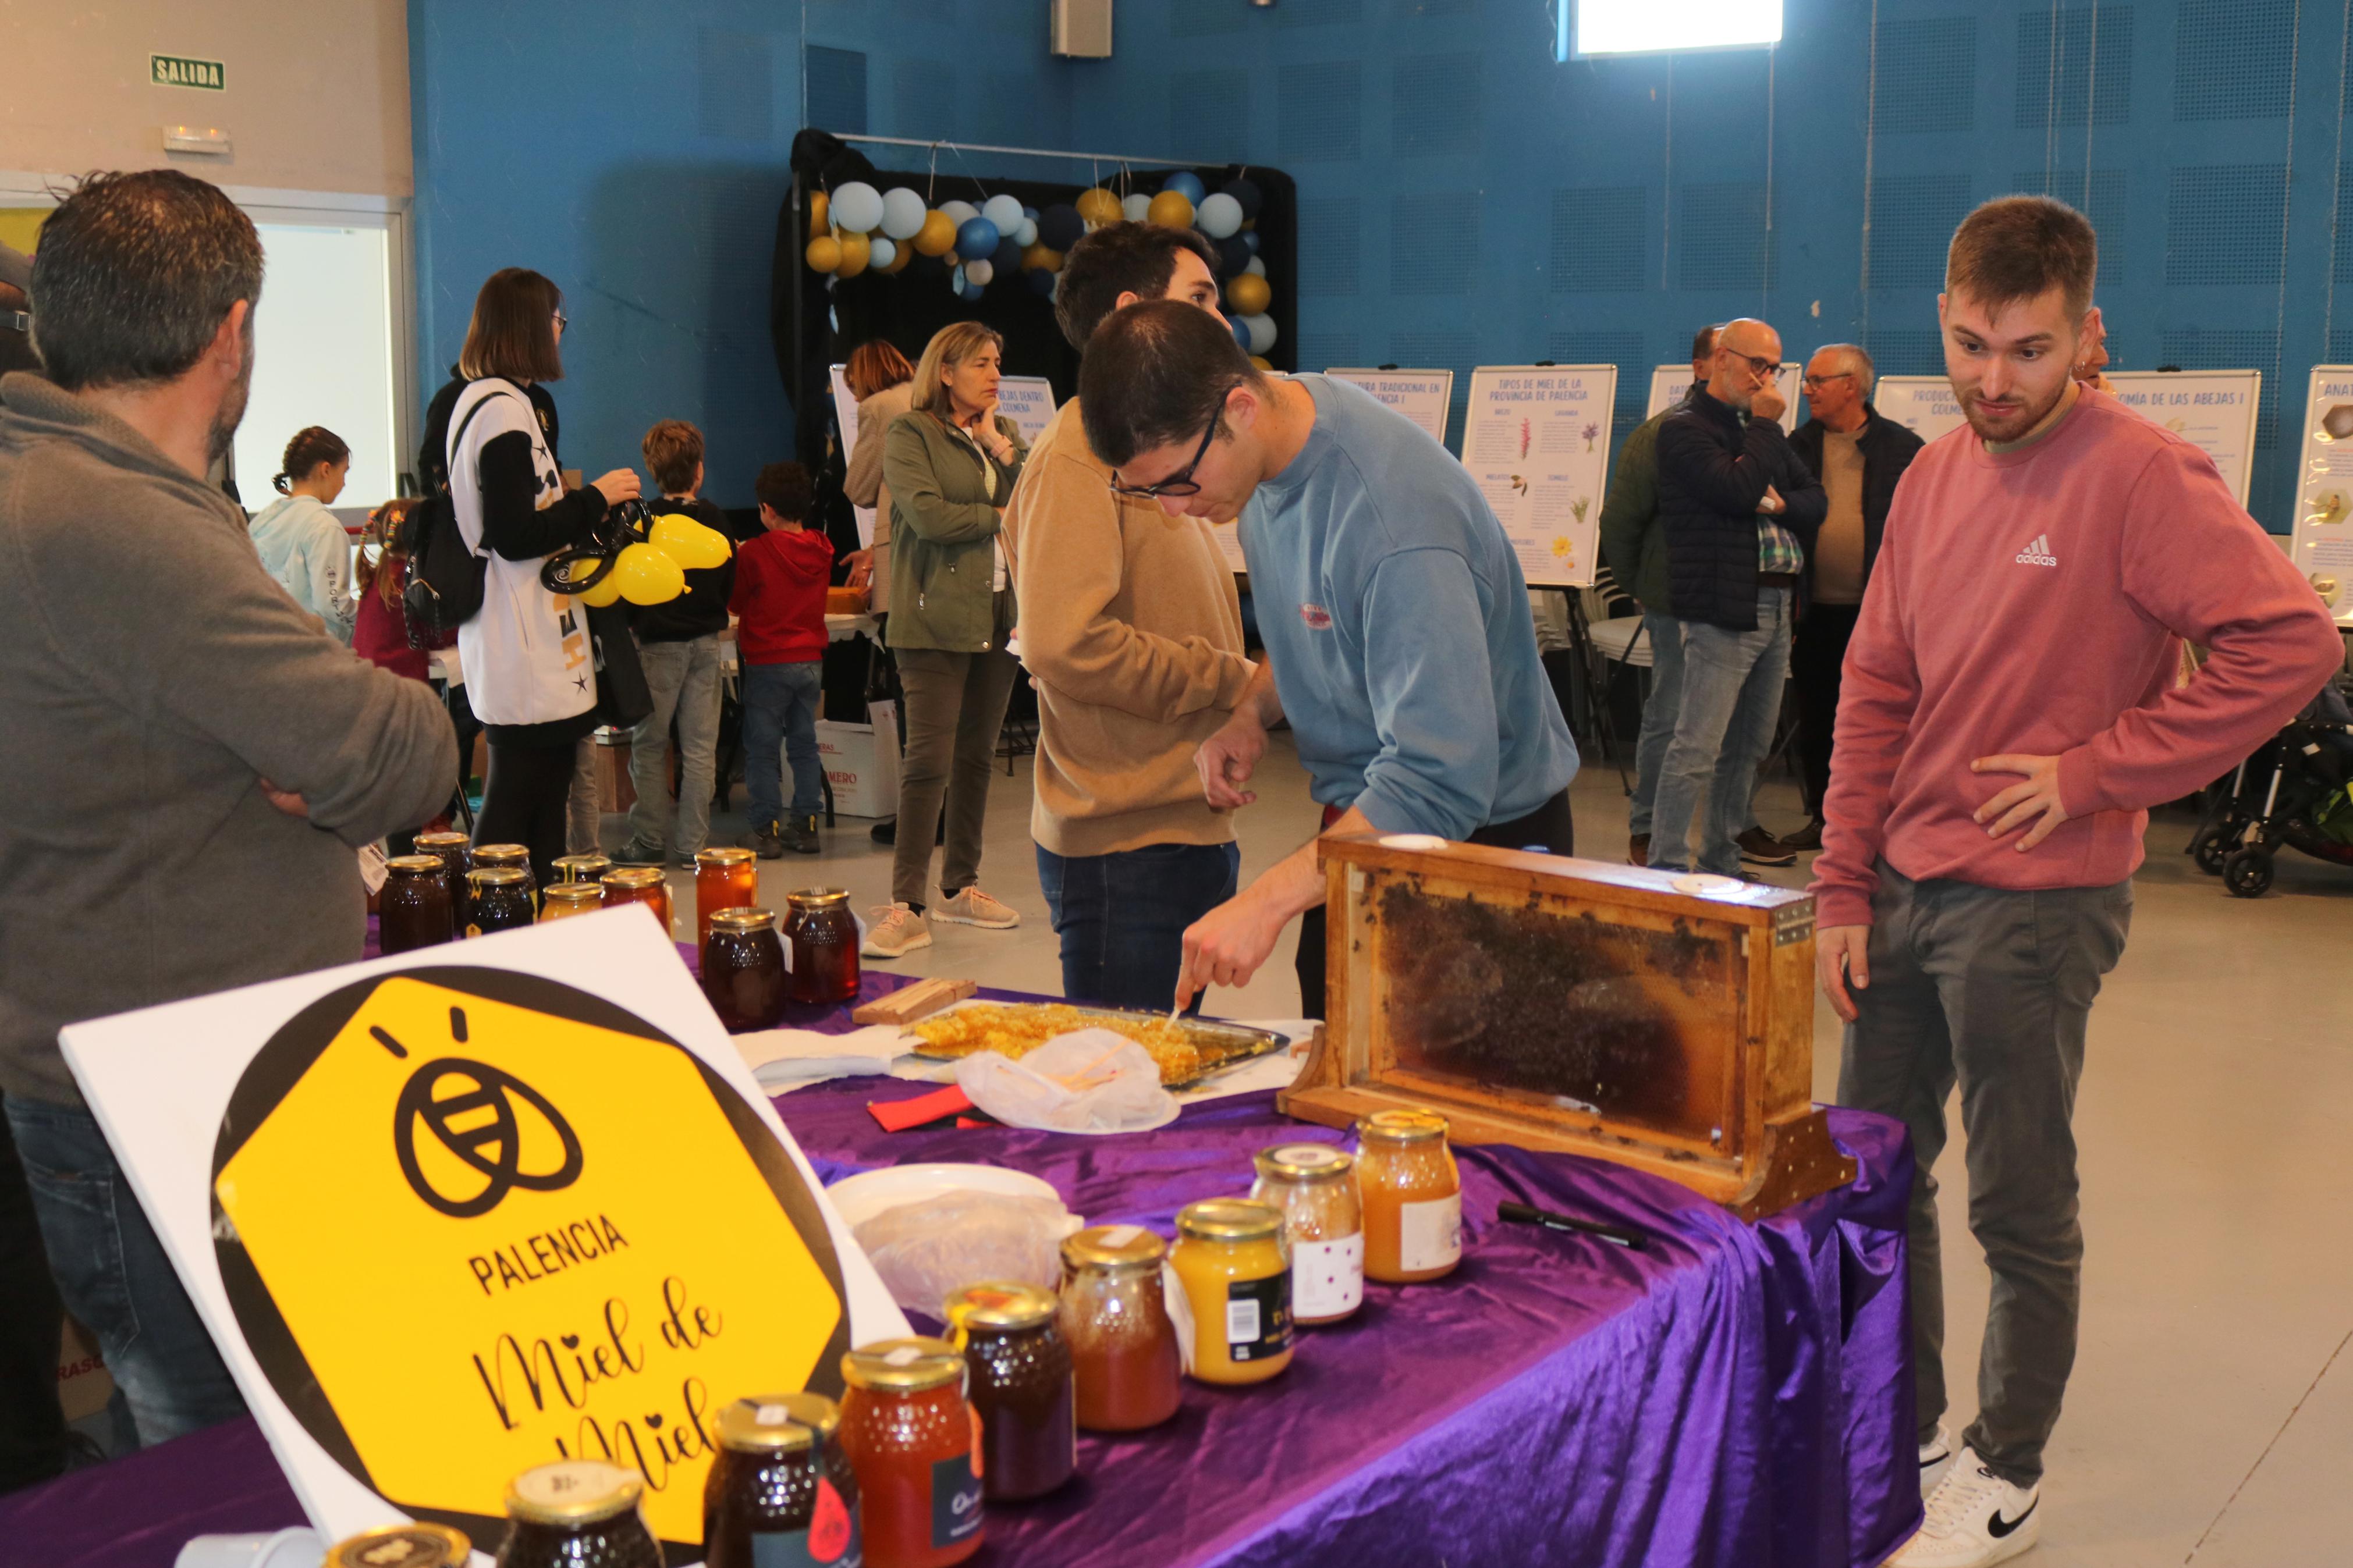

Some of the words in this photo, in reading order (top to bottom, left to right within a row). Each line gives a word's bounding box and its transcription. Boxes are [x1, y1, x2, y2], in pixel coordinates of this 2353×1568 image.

[156, 59, 219, 86] SALIDA
[1354, 382, 1375, 392] TURA
[1379, 382, 1426, 392] TRADICIONAL
[1429, 383, 1440, 393] EN
[1499, 379, 1521, 389] TIPOS
[1524, 379, 1533, 389] DE
[1537, 380, 1555, 389] MIEL
[1558, 379, 1568, 389] DE
[1571, 379, 1581, 389] LA
[998, 390, 1018, 400] BEJAS
[1374, 393, 1399, 404] ENCIA
[1489, 391, 1533, 401] PROVINCIA
[1536, 391, 1545, 401] DE
[1549, 391, 1588, 401] PALENCIA
[2119, 392, 2146, 406] OMÍA
[2152, 393, 2164, 406] DE
[2170, 393, 2189, 406] LAS
[2194, 393, 2235, 406] ABEJAS
[2240, 393, 2244, 404] I
[1932, 404, 1963, 415] COLME
[2015, 554, 2057, 567] adidas
[826, 771, 857, 784] MERO
[468, 1214, 629, 1296] PALENCIA
[473, 1297, 643, 1431] Miel
[661, 1276, 722, 1349] de
[556, 1377, 717, 1492] Miel
